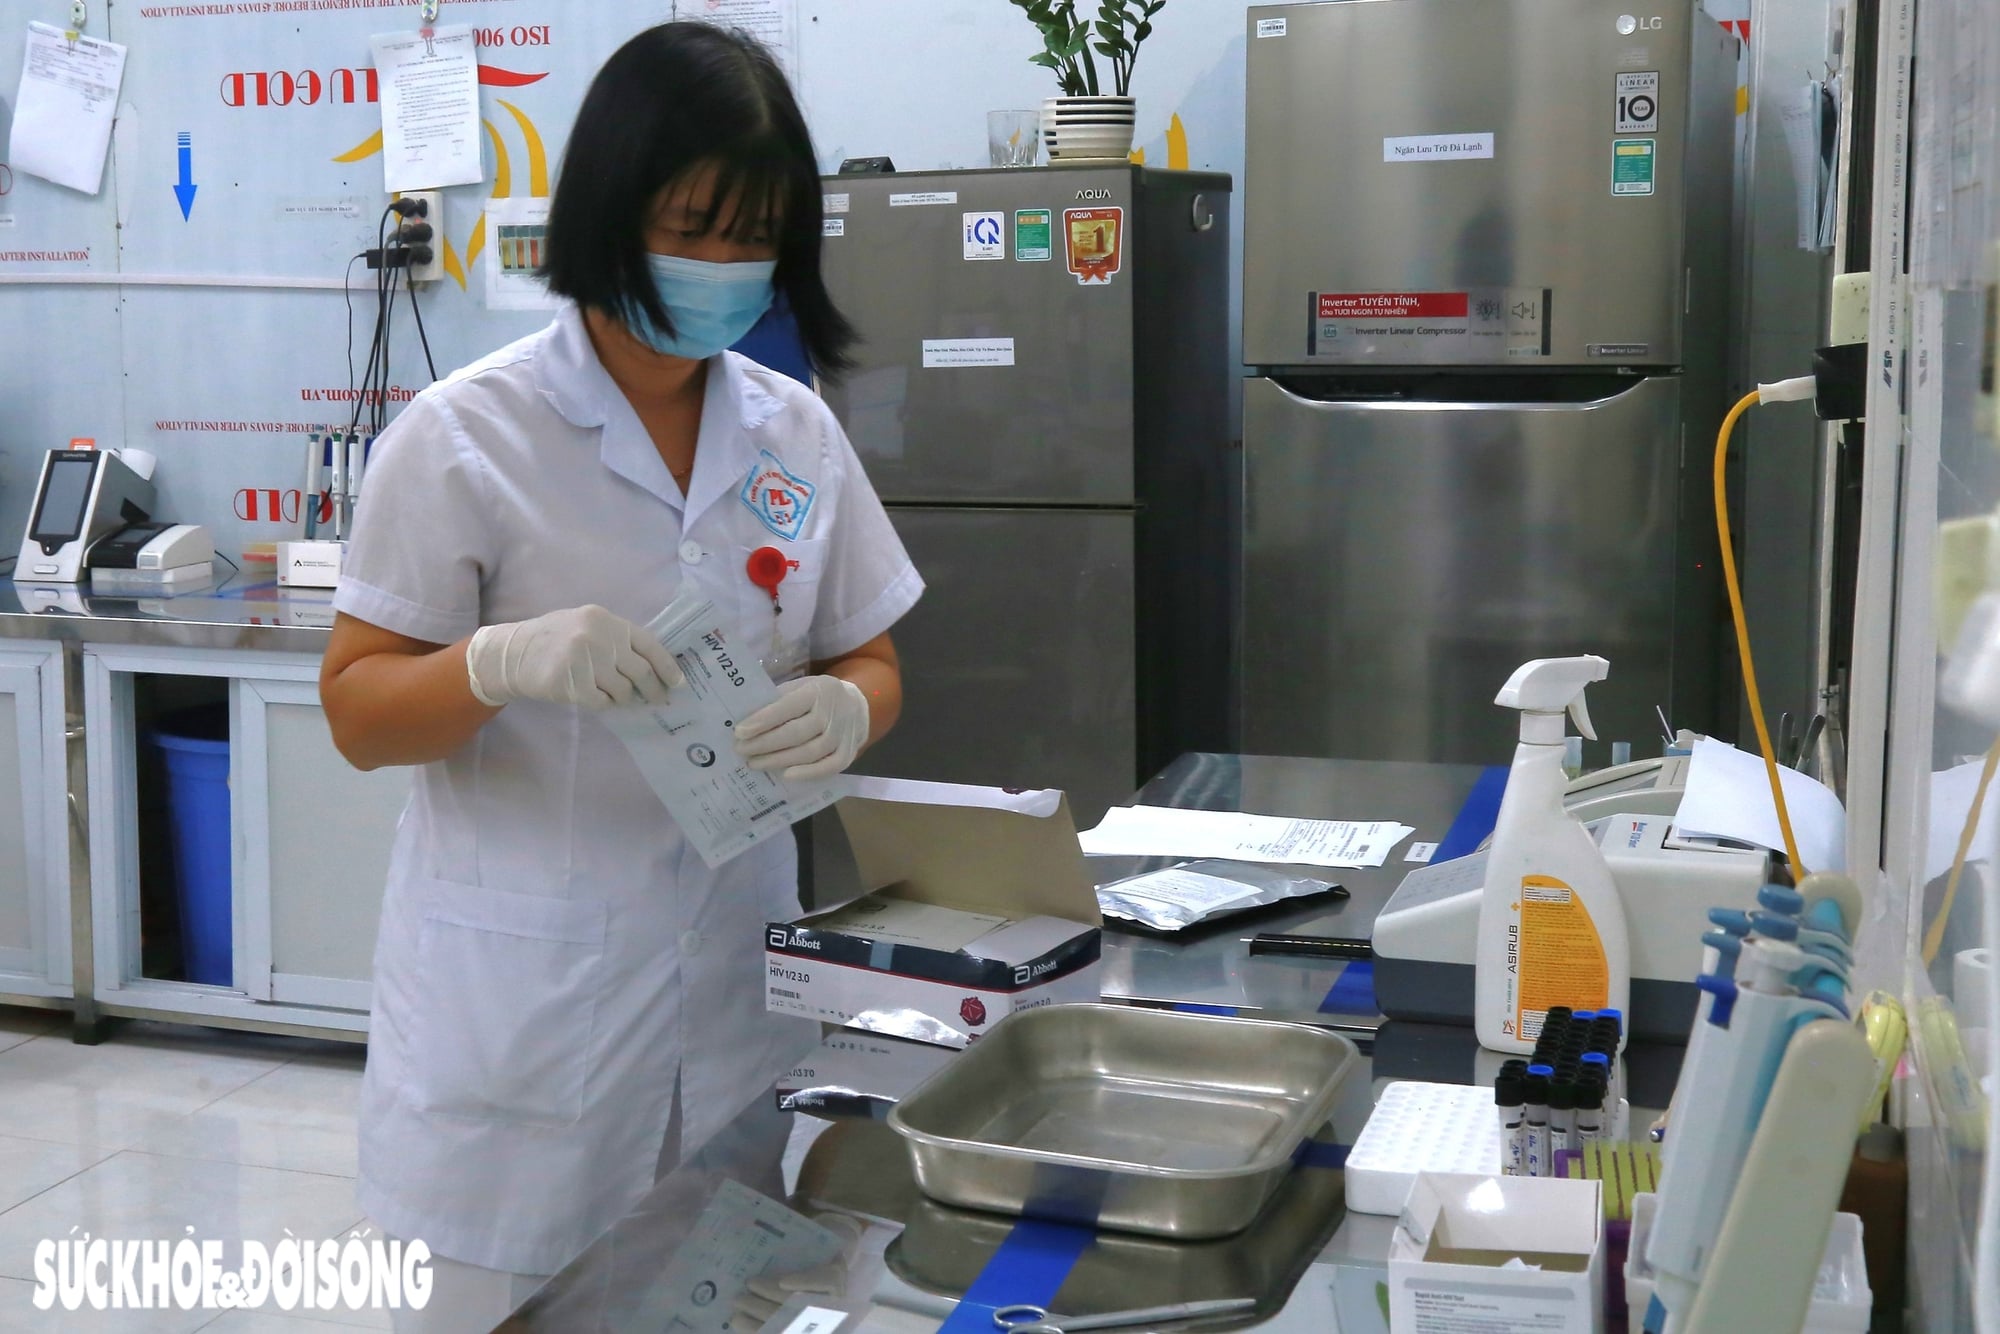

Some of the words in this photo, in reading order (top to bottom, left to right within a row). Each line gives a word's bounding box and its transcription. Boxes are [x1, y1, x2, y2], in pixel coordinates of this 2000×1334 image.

[207, 4, 235, 15] AFTER
[237, 3, 261, 14] DAYS
[262, 3, 272, 12] 45
[273, 1, 308, 12] BEFORE
[311, 0, 350, 10] REMOVE
[351, 0, 376, 8] FILM
[140, 6, 205, 18] INSTALLATION
[1639, 17, 1662, 30] LG
[472, 28, 506, 49] 900
[511, 26, 550, 46] ISO
[220, 69, 321, 107] GOLD
[330, 67, 378, 104] LU
[1620, 79, 1655, 87] LINEAR
[1619, 95, 1655, 122] 10
[1463, 142, 1483, 152] Lạnh
[1075, 189, 1111, 200] AQUA
[1070, 211, 1093, 219] AQUA
[0, 251, 26, 262] AFTER
[27, 250, 89, 262] INSTALLATION
[1321, 298, 1358, 307] Inverter
[1359, 295, 1392, 306] TUYẾN
[1394, 295, 1421, 308] TÍNH,
[1355, 327, 1388, 335] Inverter
[1389, 327, 1414, 335] Linear
[1417, 326, 1467, 336] Compressor
[1883, 350, 1893, 368] SP
[155, 420, 220, 432] INSTALLATION
[220, 421, 249, 432] AFTER
[250, 422, 274, 432] DAYS
[274, 422, 284, 433] 45
[285, 422, 320, 433] EFORE
[768, 488, 793, 506] PL
[701, 633, 724, 651] HIV
[716, 652, 733, 671] 1/2
[727, 667, 745, 687] 3.0
[788, 936, 821, 950] Abbott
[1507, 925, 1518, 974] ASIRUB
[1032, 960, 1057, 976] Abbott
[769, 966, 784, 977] HIV
[785, 970, 797, 981] 1/2
[797, 972, 810, 984] 3.0
